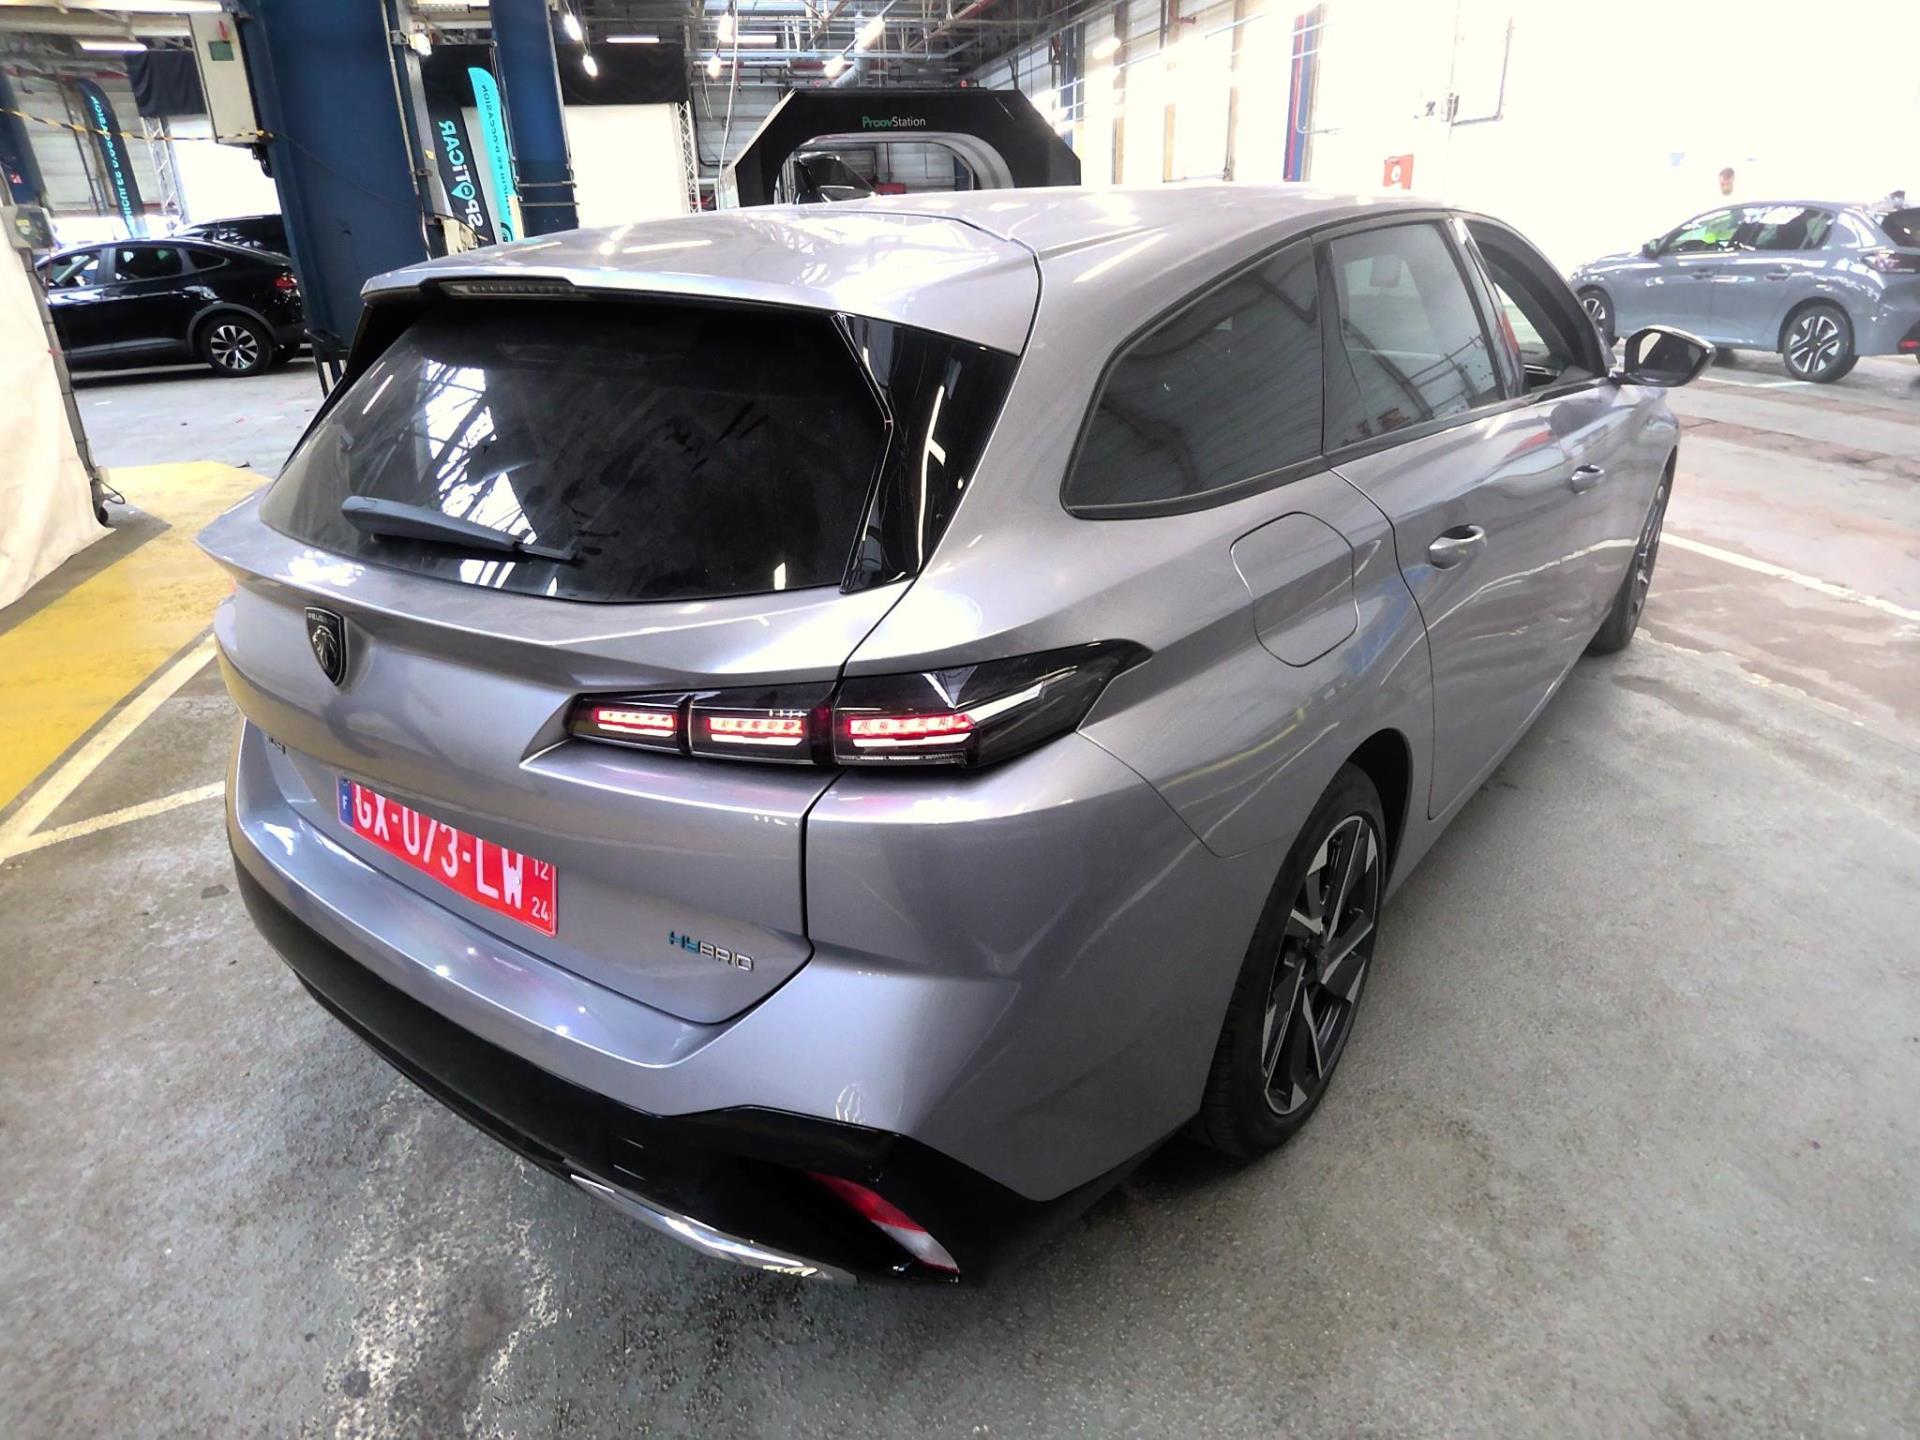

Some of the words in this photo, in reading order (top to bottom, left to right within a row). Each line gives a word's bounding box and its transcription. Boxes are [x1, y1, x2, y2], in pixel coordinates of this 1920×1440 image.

[862, 116, 926, 128] ProovStation
[532, 859, 549, 881] 12
[531, 896, 549, 922] 24
[668, 931, 754, 972] HYBRID
